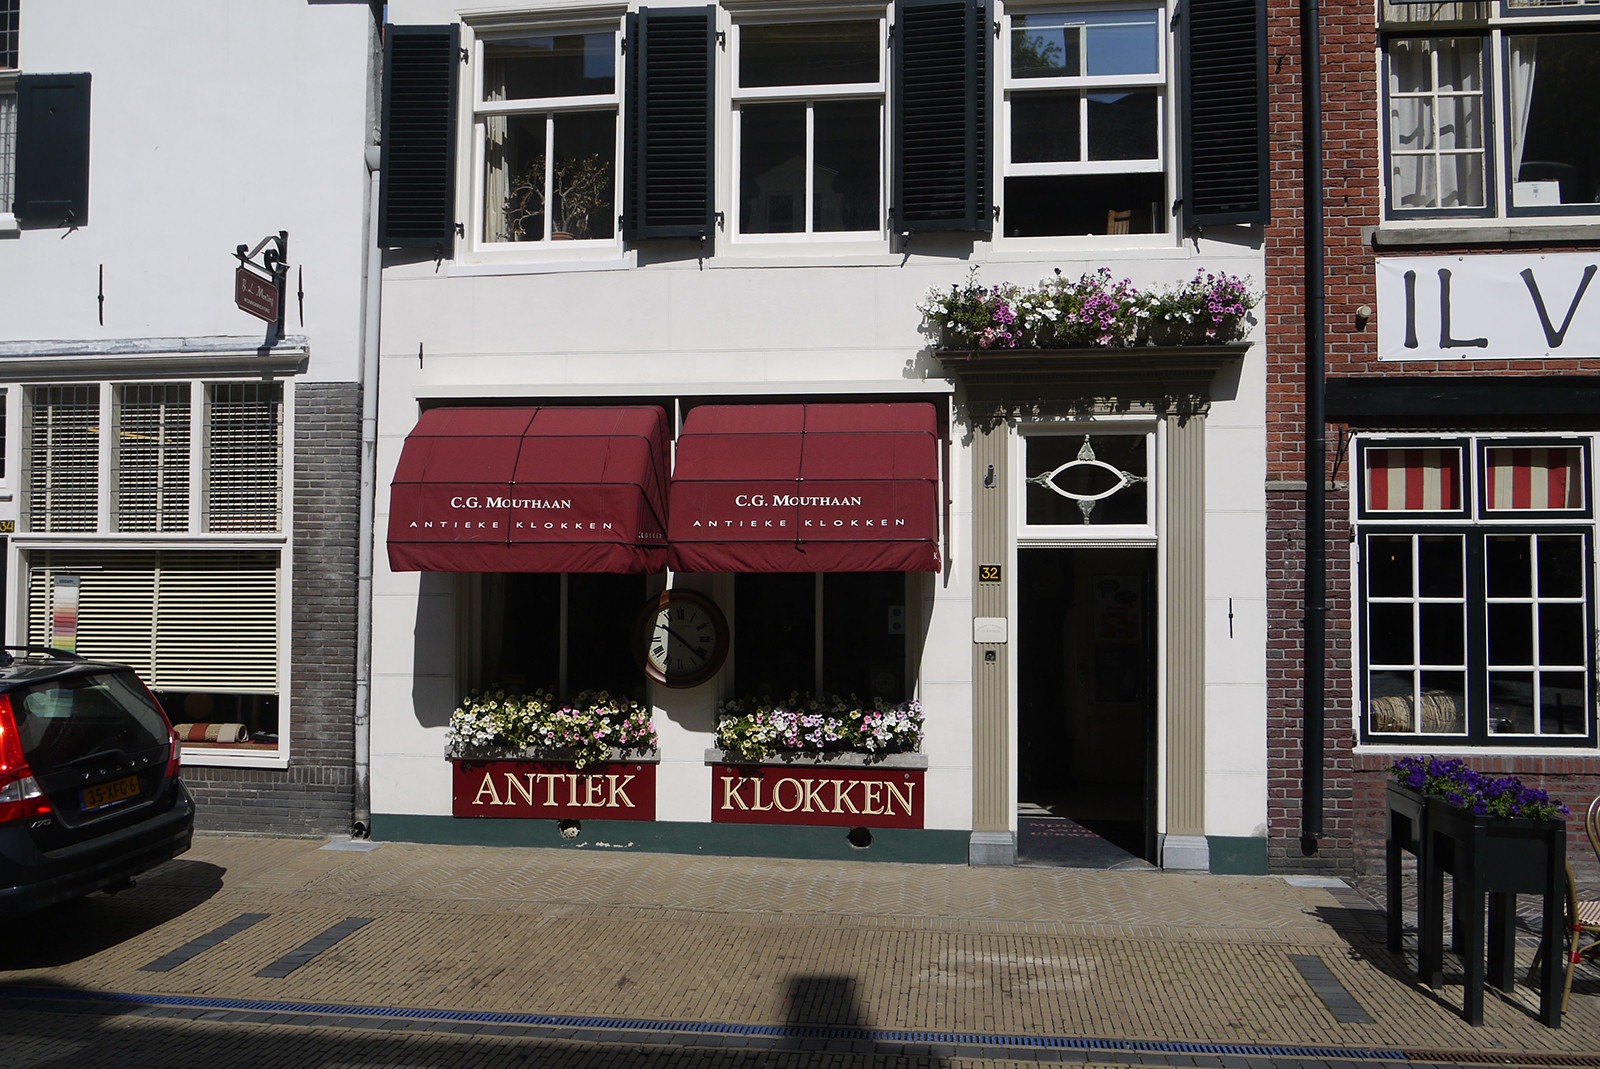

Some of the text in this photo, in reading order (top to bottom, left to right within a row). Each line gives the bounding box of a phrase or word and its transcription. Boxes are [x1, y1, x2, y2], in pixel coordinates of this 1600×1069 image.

[1404, 264, 1598, 349] IL V
[451, 496, 482, 508] C.G.
[735, 494, 768, 506] C.G.
[0, 521, 14, 532] 34
[516, 521, 612, 529] KLOKKEN
[805, 518, 904, 526] KLOKKEN
[981, 567, 999, 579] 32
[87, 777, 137, 806] 35-XFG-6
[472, 772, 636, 808] ANTIEK
[720, 776, 916, 817] KLOKKEN
